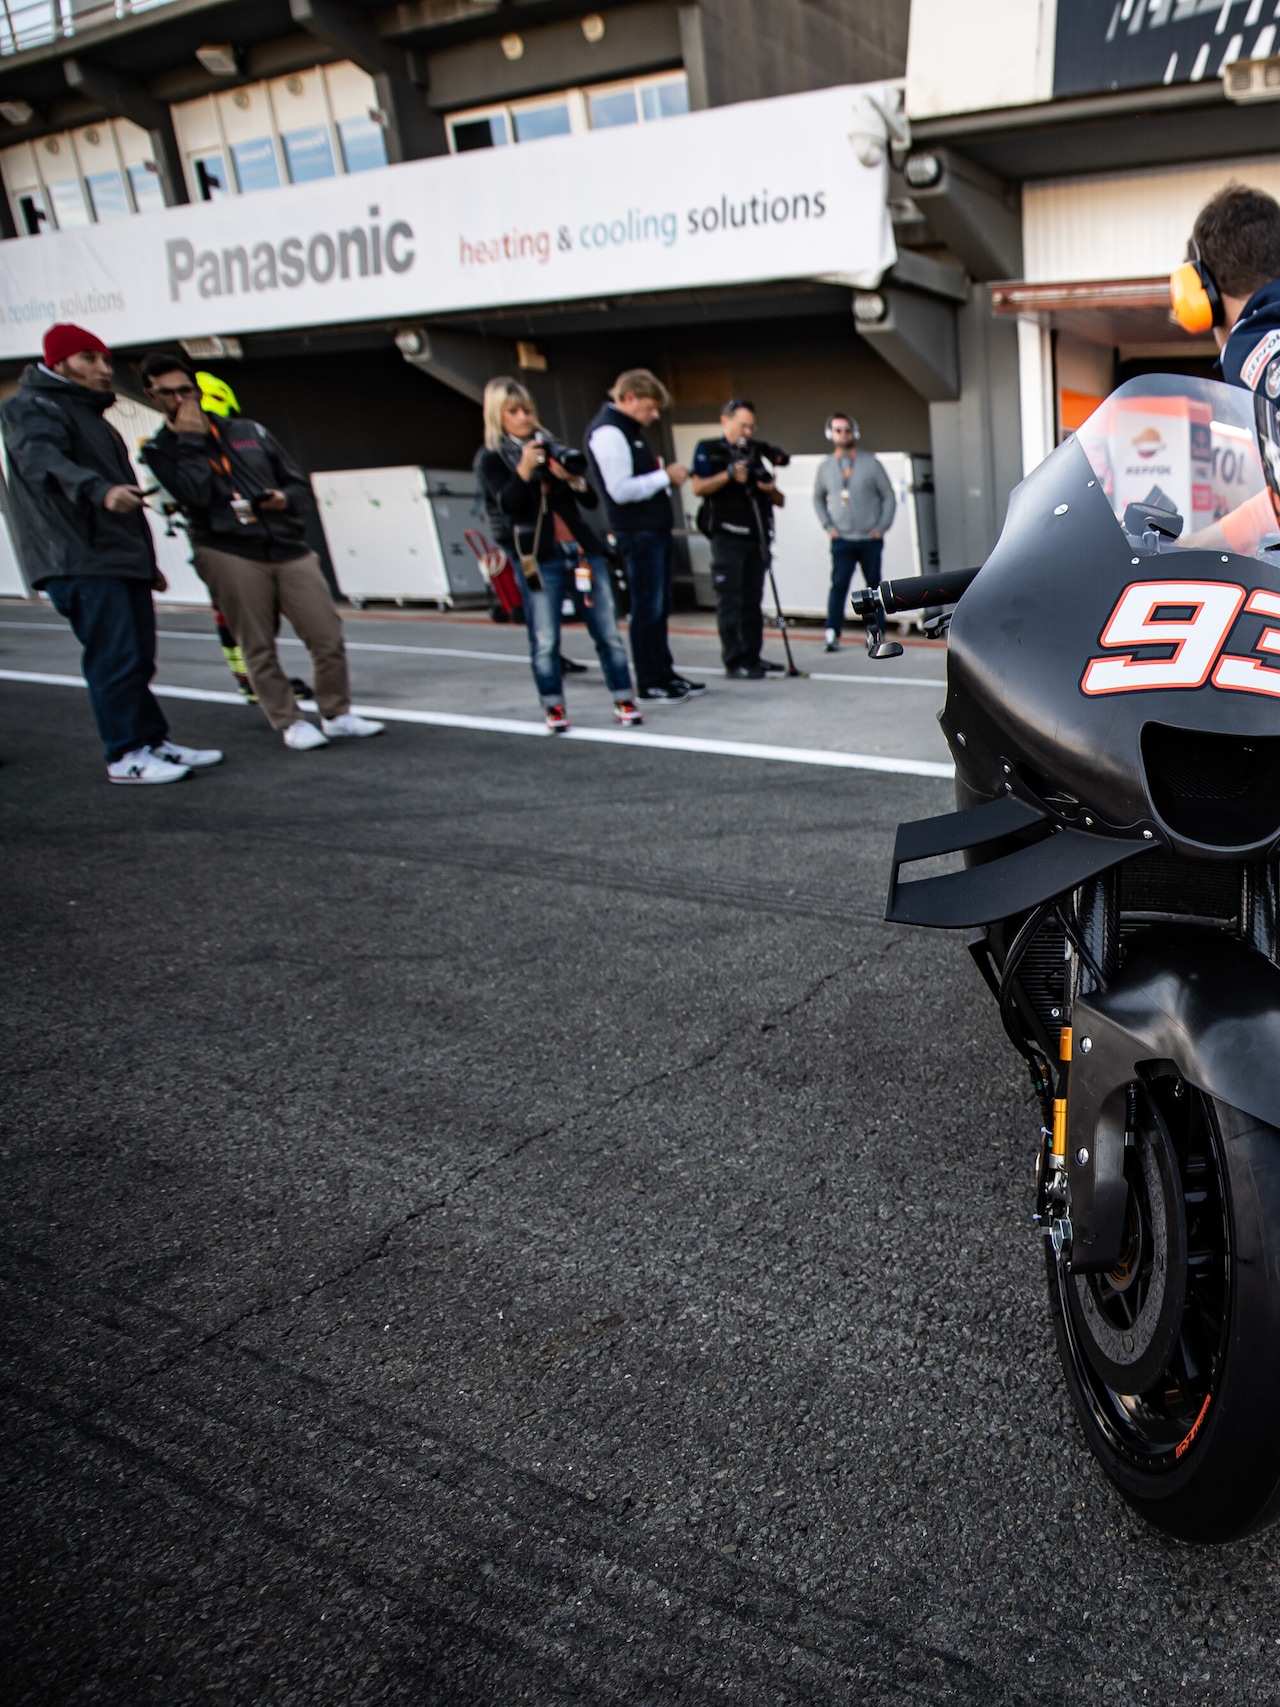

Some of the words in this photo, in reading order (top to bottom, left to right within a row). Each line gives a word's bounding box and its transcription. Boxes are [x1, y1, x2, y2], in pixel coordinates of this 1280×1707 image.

[165, 204, 416, 302] Panasonic
[459, 227, 551, 267] heating
[557, 225, 572, 253] &
[579, 208, 678, 248] cooling
[687, 188, 827, 235] solutions
[59, 287, 125, 318] solutions
